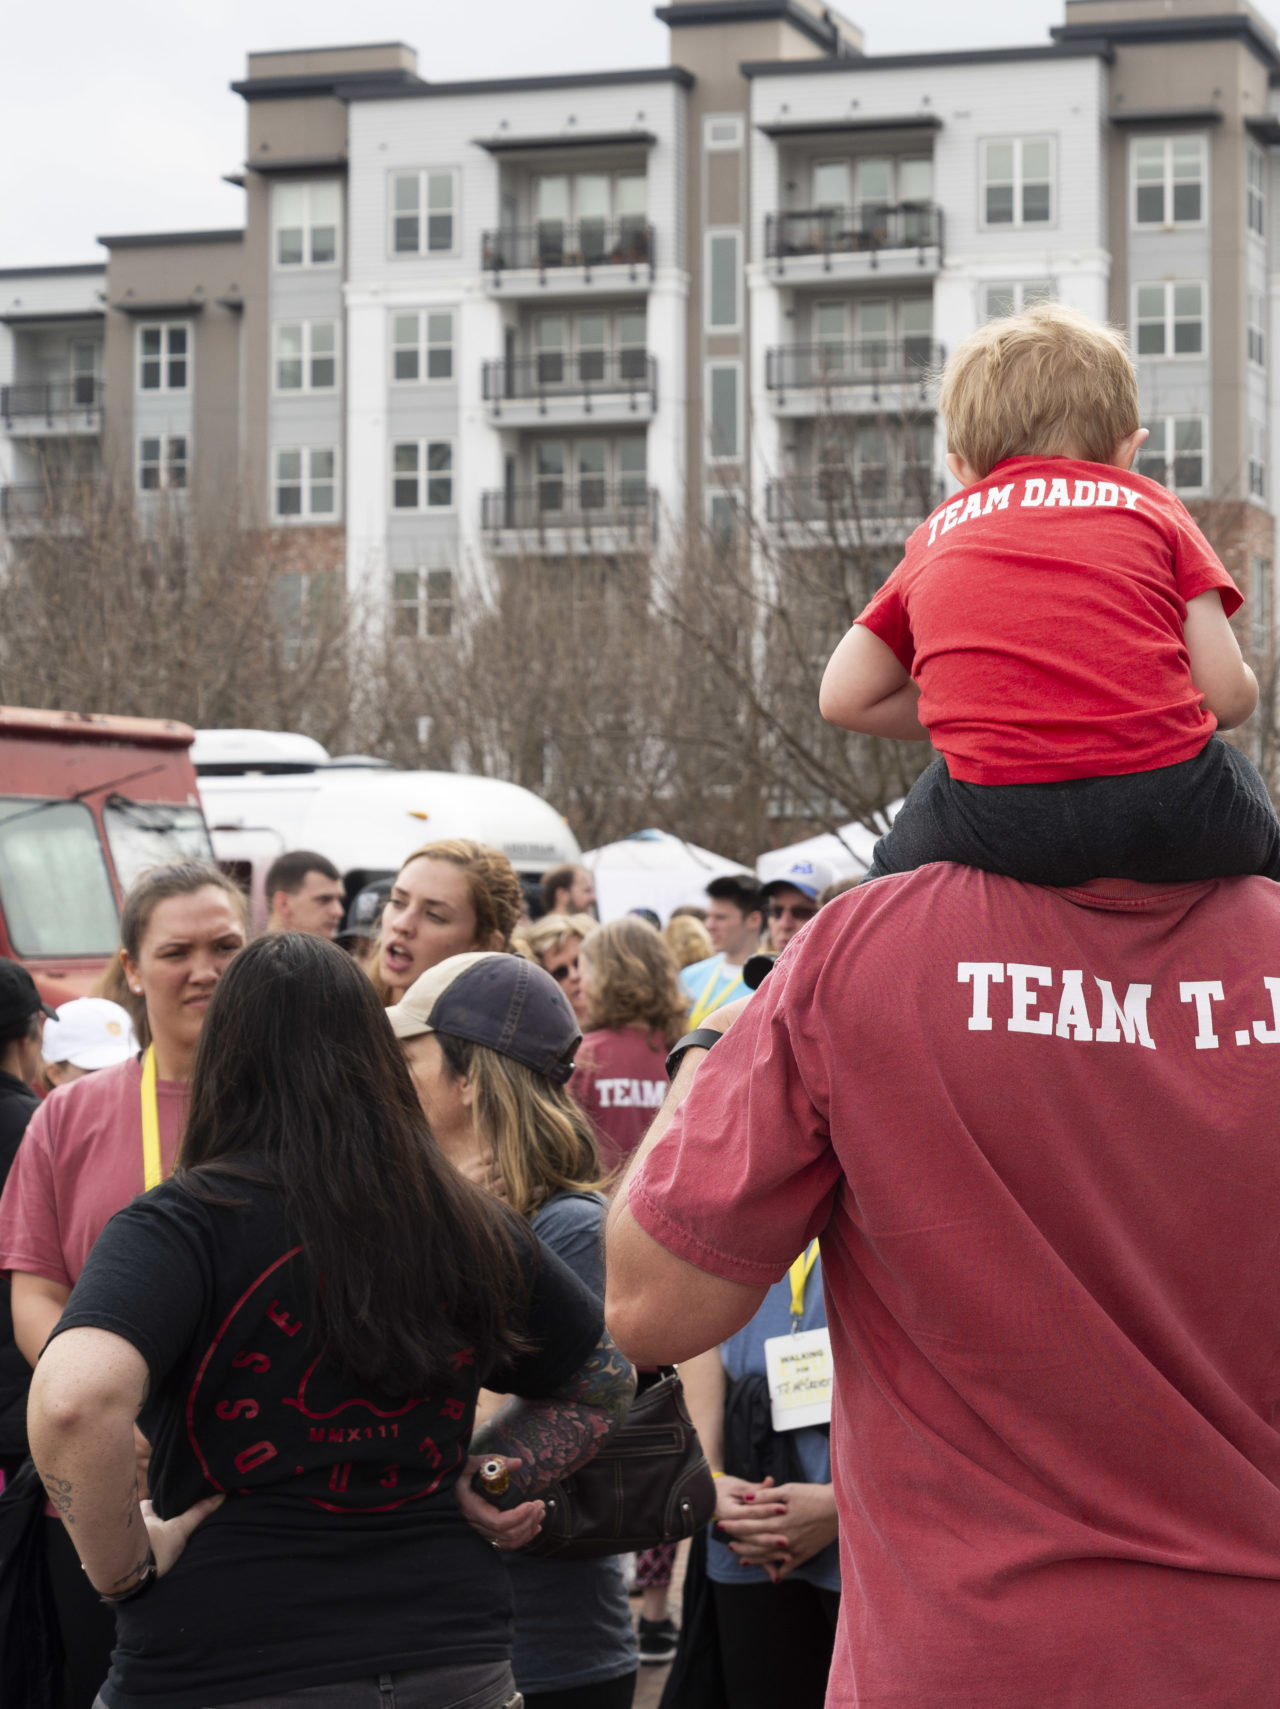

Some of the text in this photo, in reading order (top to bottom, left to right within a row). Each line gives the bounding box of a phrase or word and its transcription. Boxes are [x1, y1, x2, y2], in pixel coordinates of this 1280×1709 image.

[927, 478, 1142, 546] TEAM DADDY
[957, 962, 1157, 1050] TEAM
[595, 1078, 667, 1108] TEAM
